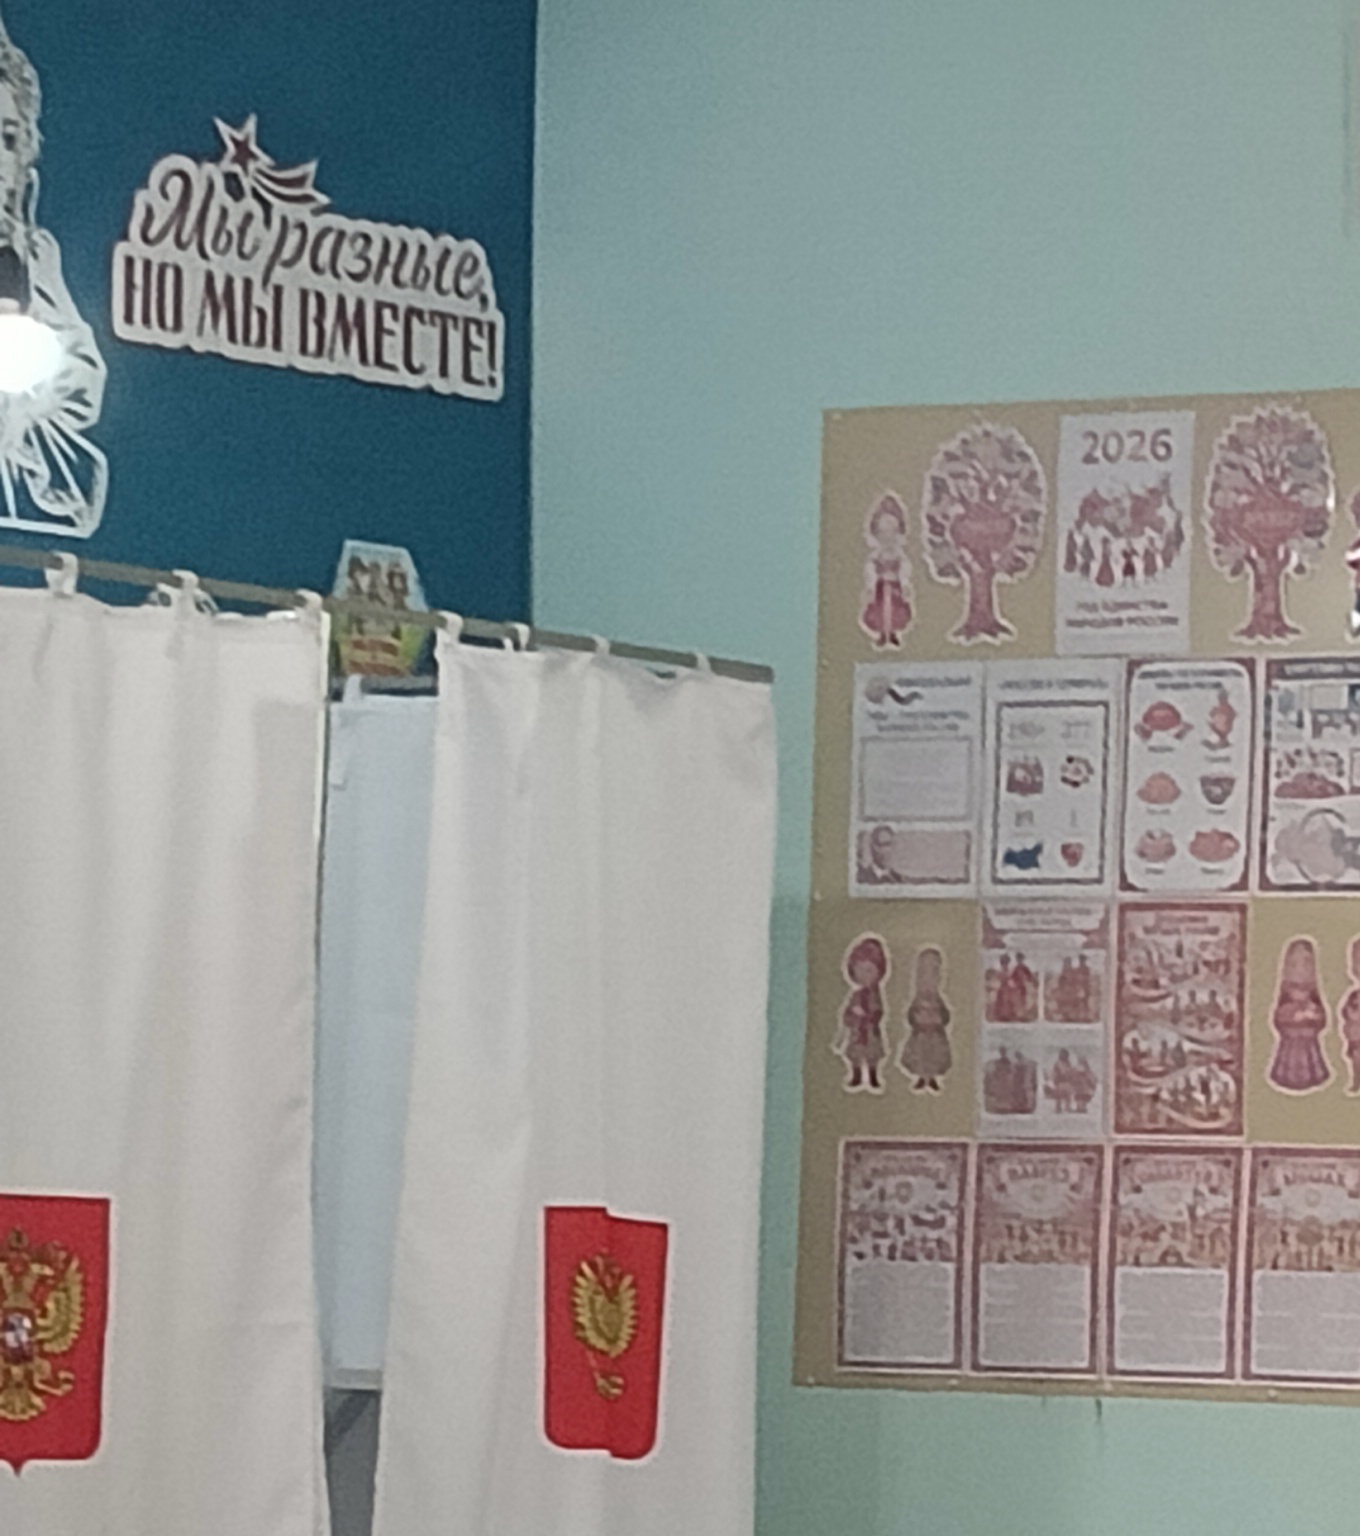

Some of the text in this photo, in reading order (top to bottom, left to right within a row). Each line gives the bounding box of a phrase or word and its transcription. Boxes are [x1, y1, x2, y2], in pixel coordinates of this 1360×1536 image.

[124, 254, 497, 389] НО МЫ ВМЕСТЕ!
[1081, 427, 1173, 466] 2026
